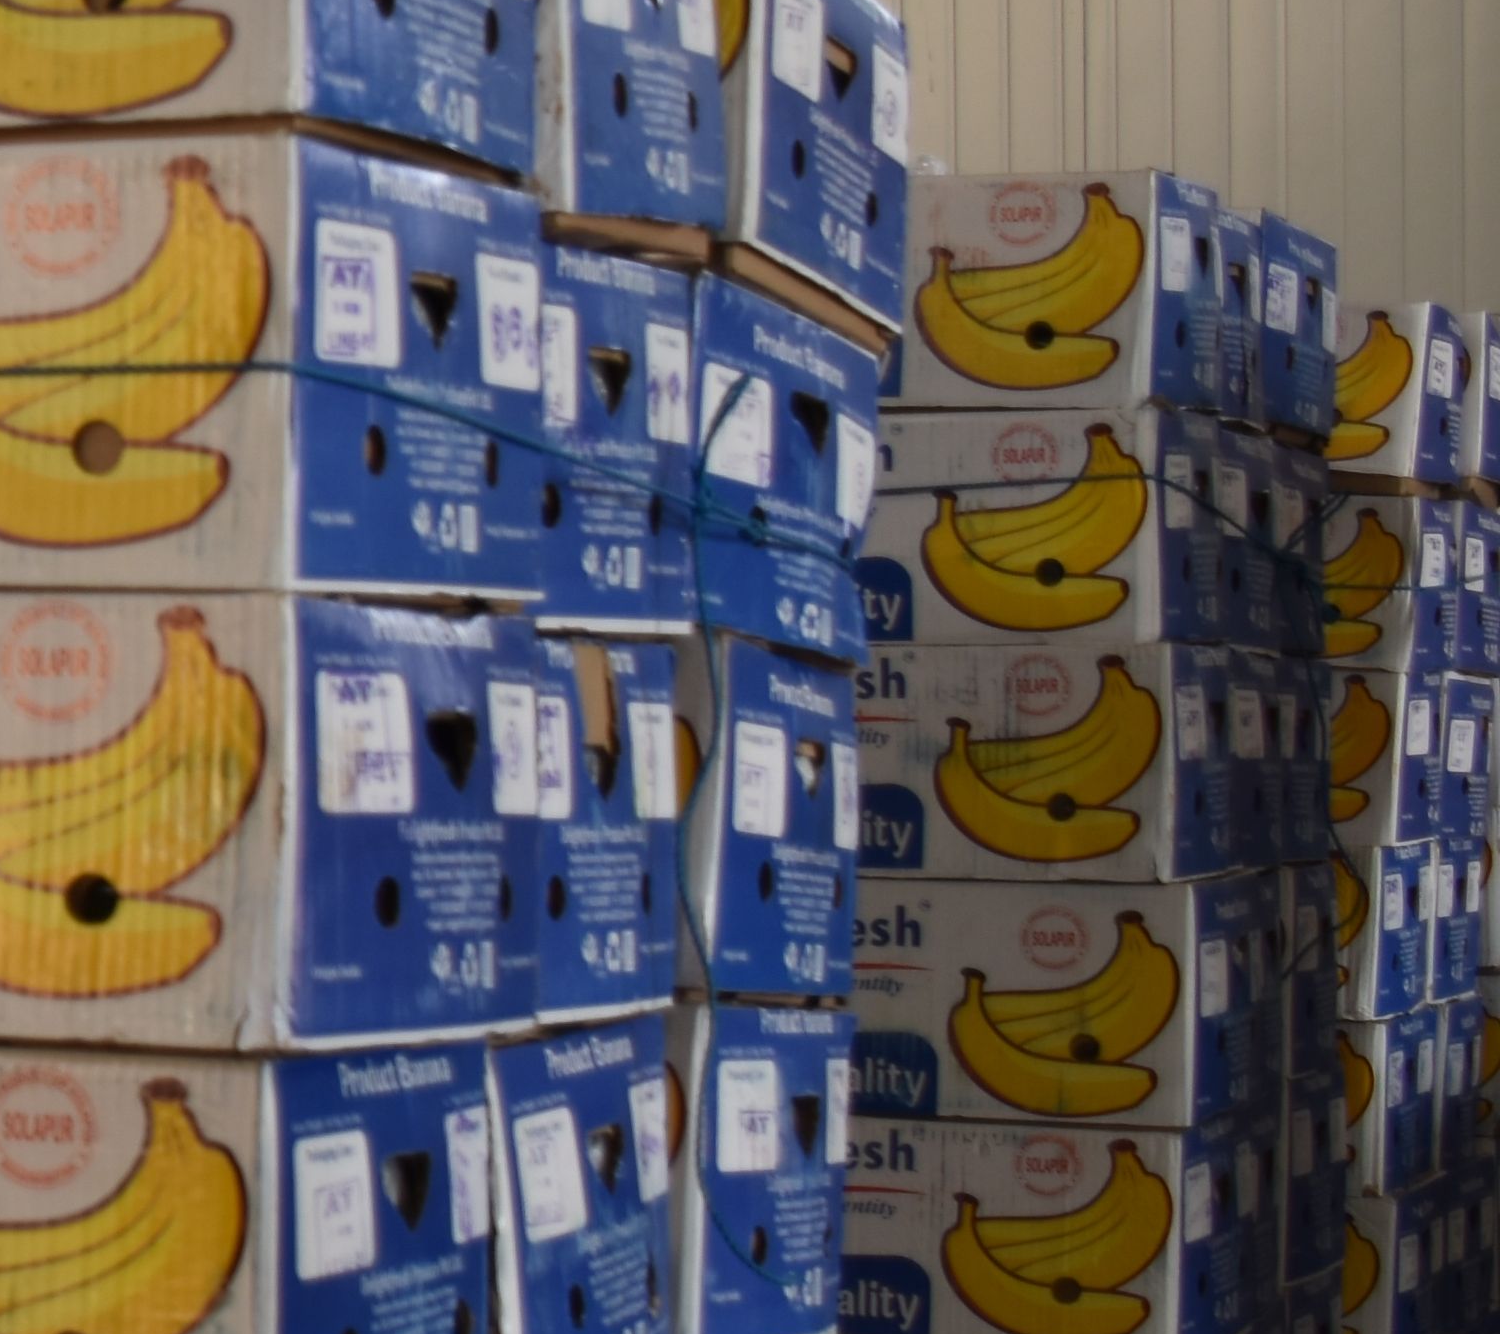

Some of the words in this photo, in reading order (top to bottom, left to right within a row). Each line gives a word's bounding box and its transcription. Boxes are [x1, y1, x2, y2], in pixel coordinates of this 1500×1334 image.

[26, 199, 97, 230] SOLAPUR
[20, 645, 91, 673] SOLAPUR
[845, 1061, 926, 1108] ality
[3, 1112, 74, 1142] SOLAPUR
[838, 1278, 920, 1331] ality
